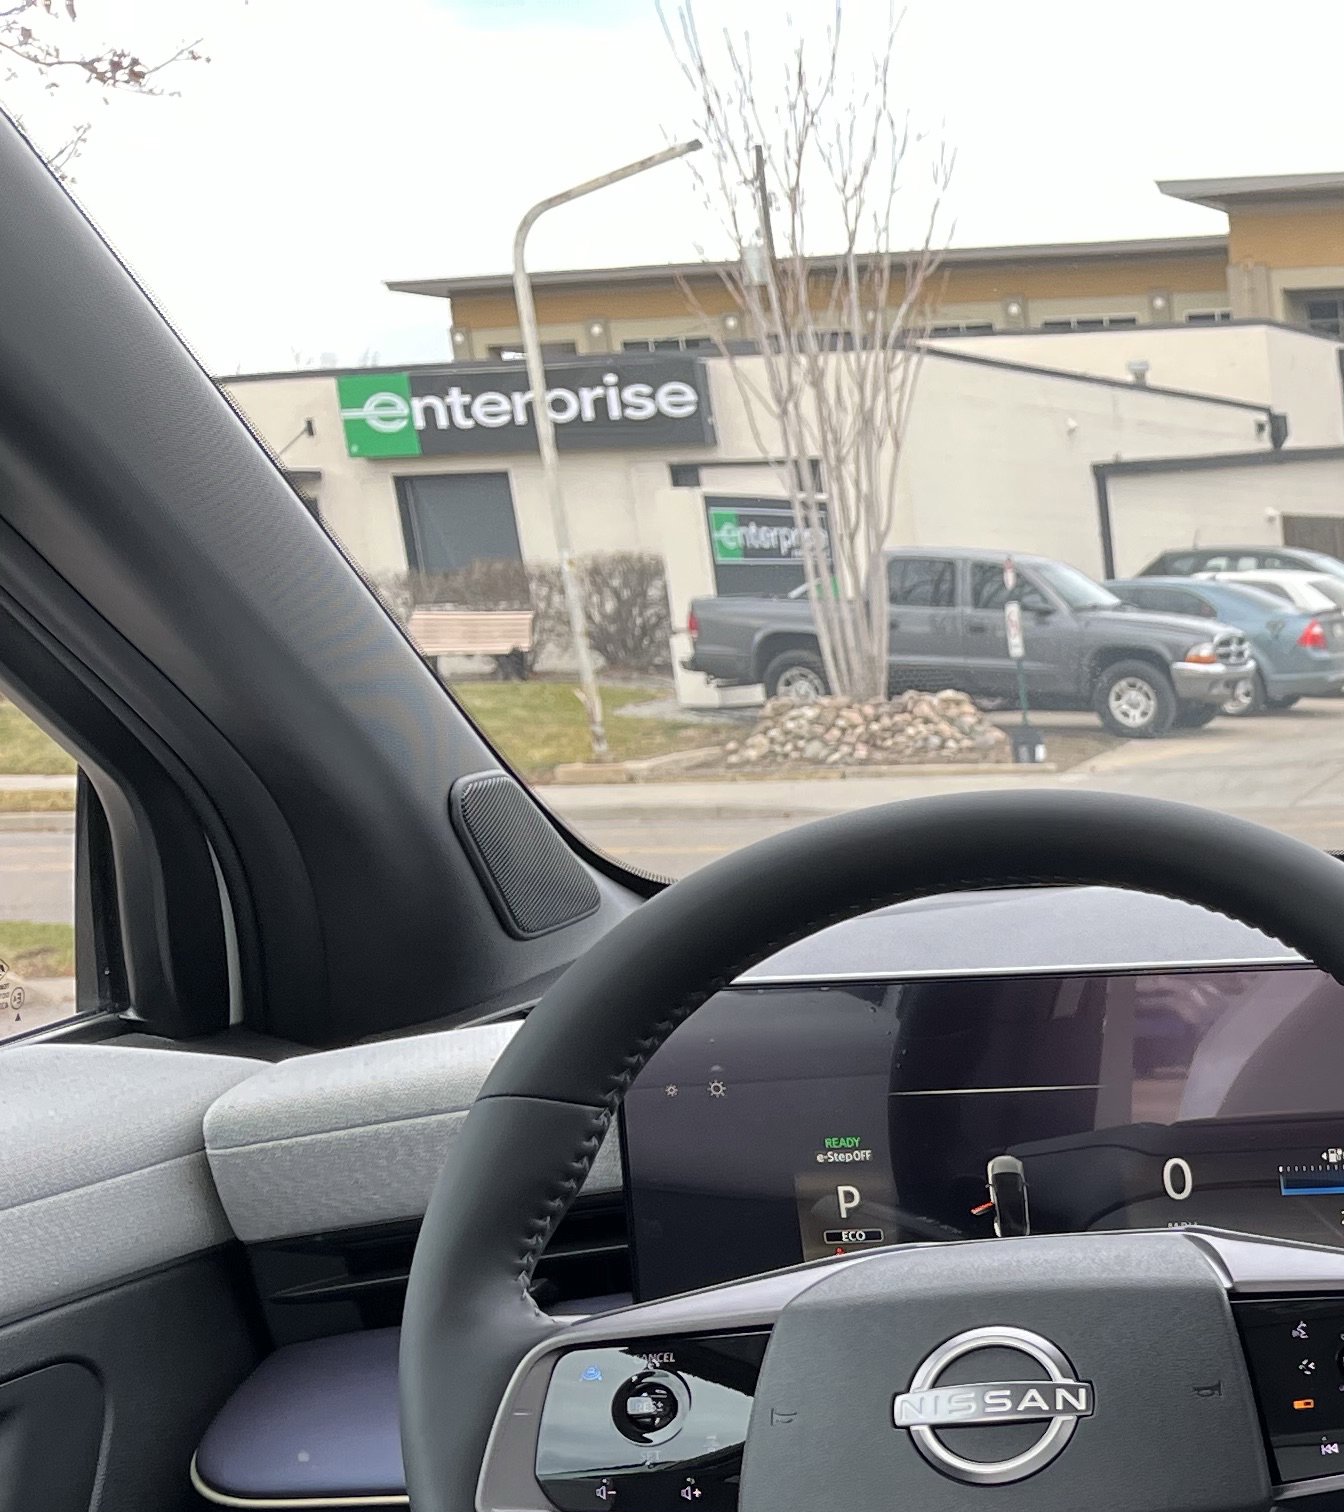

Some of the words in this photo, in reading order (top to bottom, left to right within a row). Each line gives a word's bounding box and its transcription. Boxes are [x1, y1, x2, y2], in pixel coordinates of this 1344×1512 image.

[825, 1137, 860, 1148] READY
[1163, 1157, 1192, 1200] 0
[837, 1185, 860, 1218] P
[842, 1230, 866, 1242] ECO
[633, 1353, 676, 1364] ANCEL
[901, 1388, 1086, 1422] NISSAN
